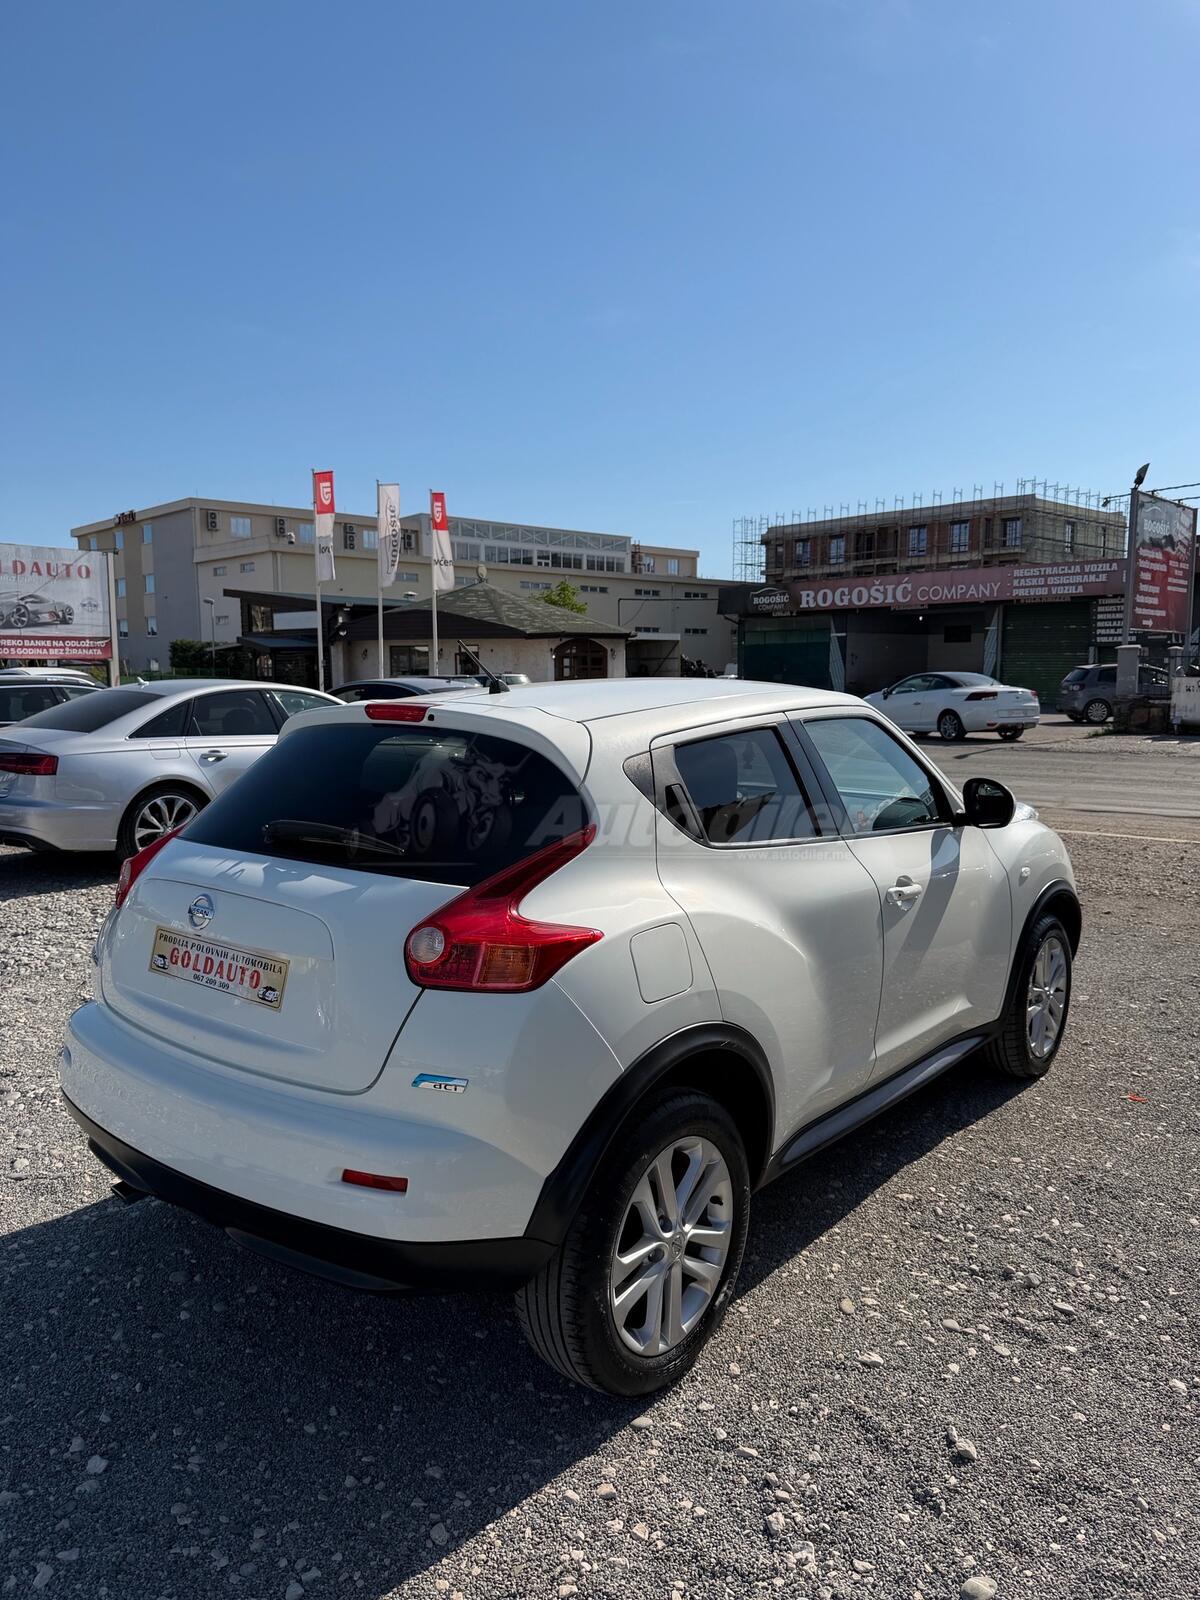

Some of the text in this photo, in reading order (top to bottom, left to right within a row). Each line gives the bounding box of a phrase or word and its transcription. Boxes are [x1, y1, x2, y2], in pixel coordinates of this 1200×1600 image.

[1013, 563, 1118, 578] REGISTRACIJA VOZILA
[1012, 574, 1108, 587] KASKO OSIGURANJE
[799, 578, 1001, 608] ROGOŠIĆ COMPANY
[1051, 585, 1084, 595] VOZILA
[753, 593, 790, 605] ROGOŠIĆ
[24, 639, 51, 647] BANKE
[17, 648, 48, 656] GODINA
[191, 941, 230, 959] POLOVNIH
[230, 952, 283, 976] AUTOMOBILA
[169, 946, 262, 990] GOLDAUTO
